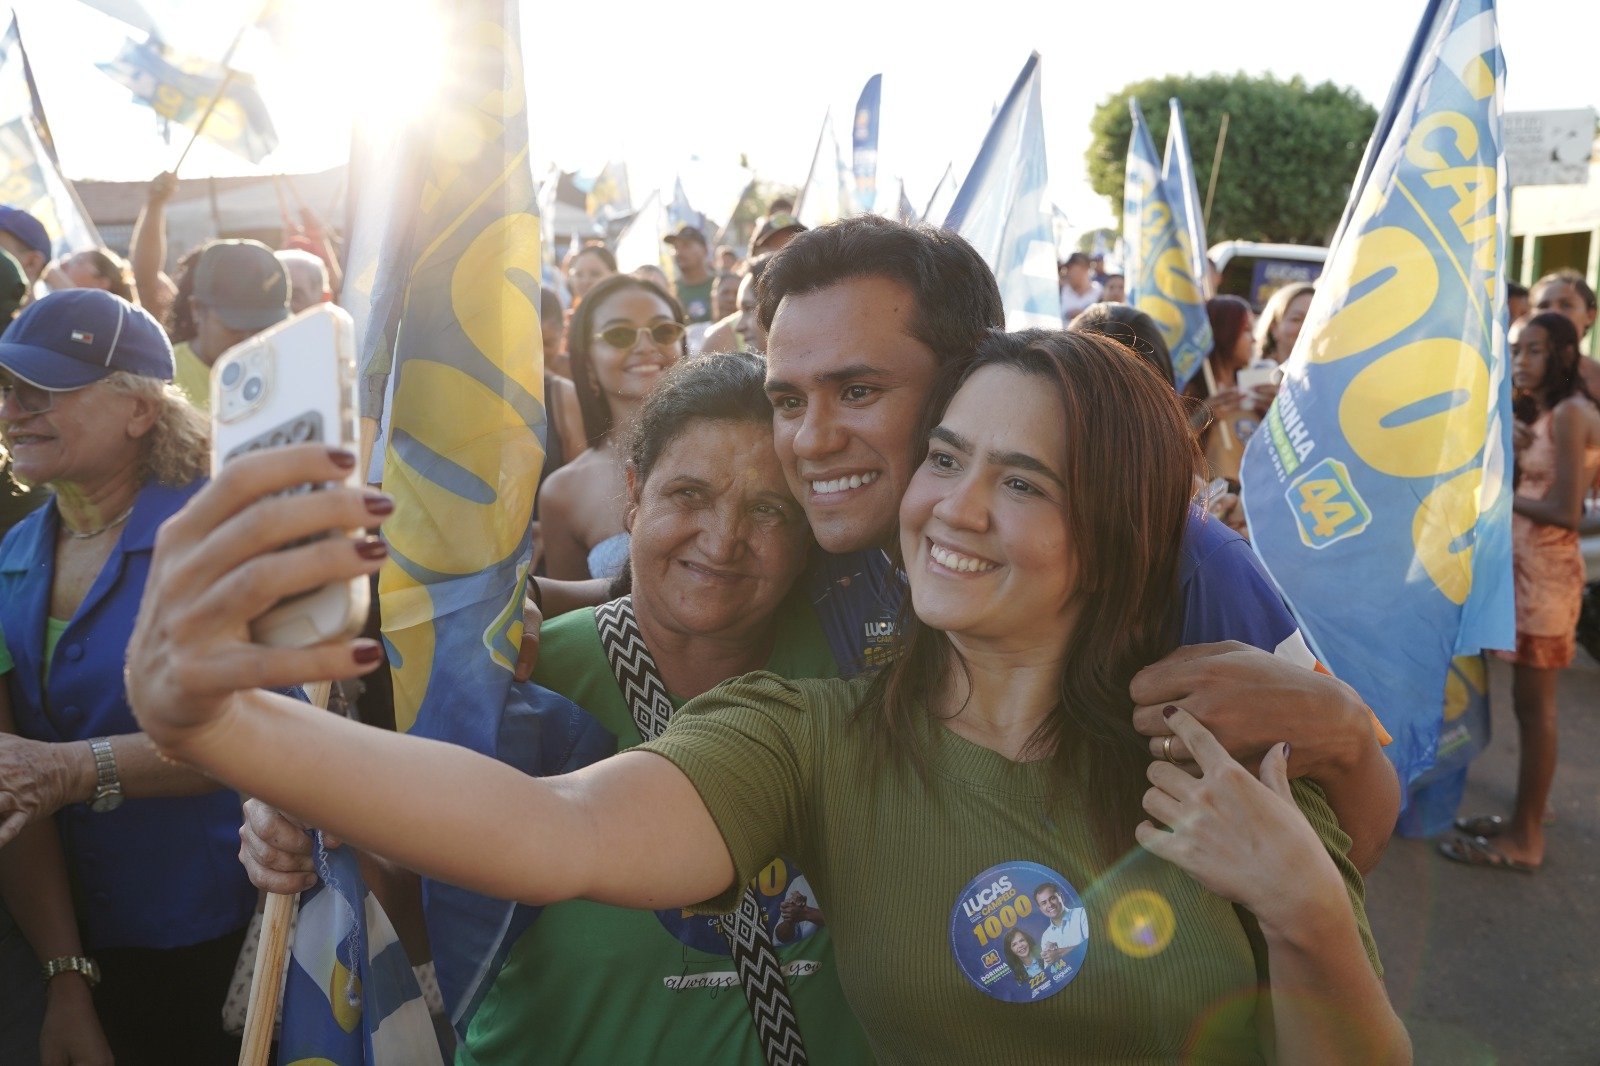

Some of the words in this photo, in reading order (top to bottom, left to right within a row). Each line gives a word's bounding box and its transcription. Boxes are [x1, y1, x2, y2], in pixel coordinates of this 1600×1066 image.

[1299, 478, 1357, 538] 44
[865, 621, 896, 637] LUCA
[962, 875, 1013, 918] LUCAS
[981, 888, 1017, 916] CAMPELO
[973, 894, 1033, 947] 1000
[665, 964, 738, 1000] always
[1029, 971, 1047, 989] 222
